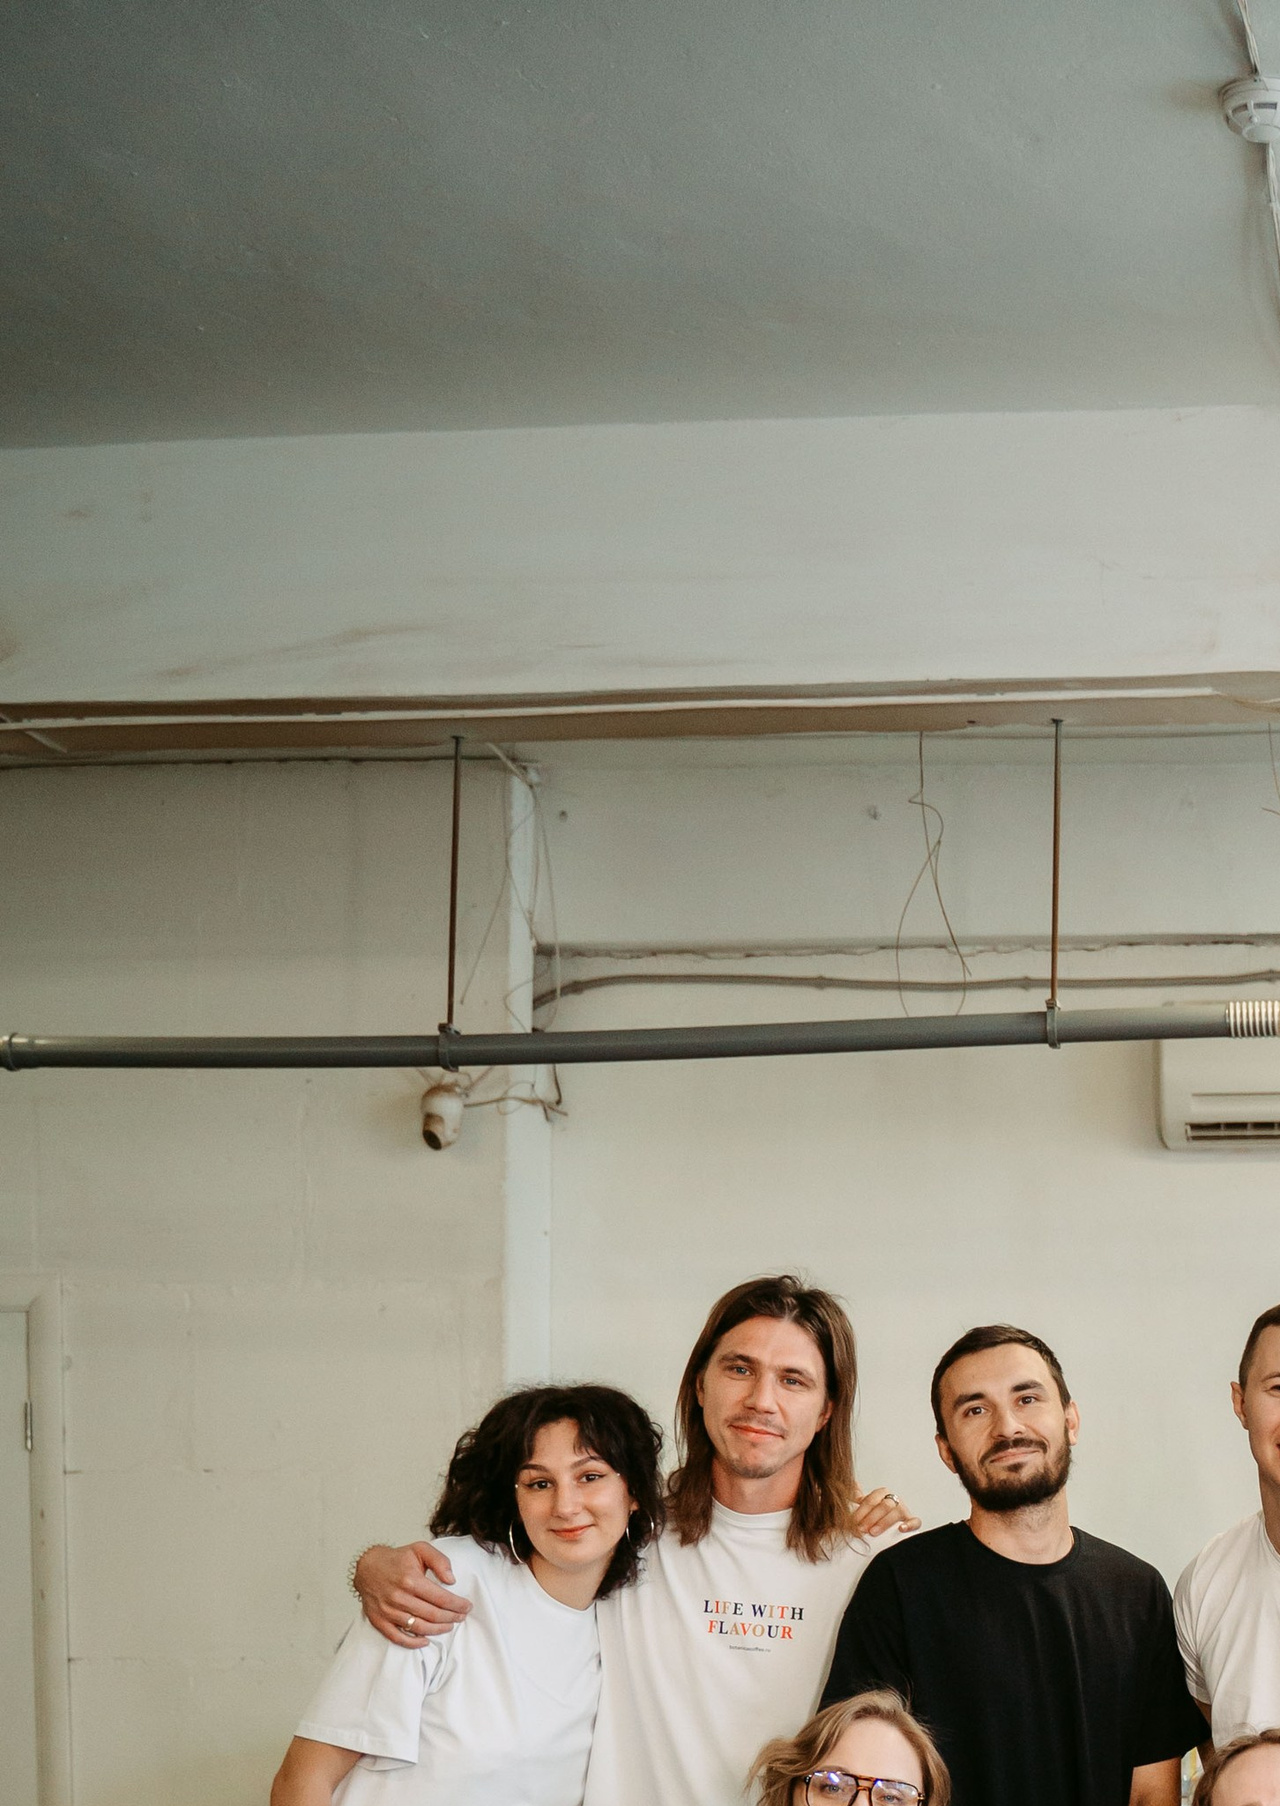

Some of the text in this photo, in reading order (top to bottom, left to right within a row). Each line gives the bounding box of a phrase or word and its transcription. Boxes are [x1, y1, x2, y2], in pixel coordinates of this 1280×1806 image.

[703, 1599, 804, 1620] LIFE WITH
[707, 1619, 793, 1639] FLAVOUR
